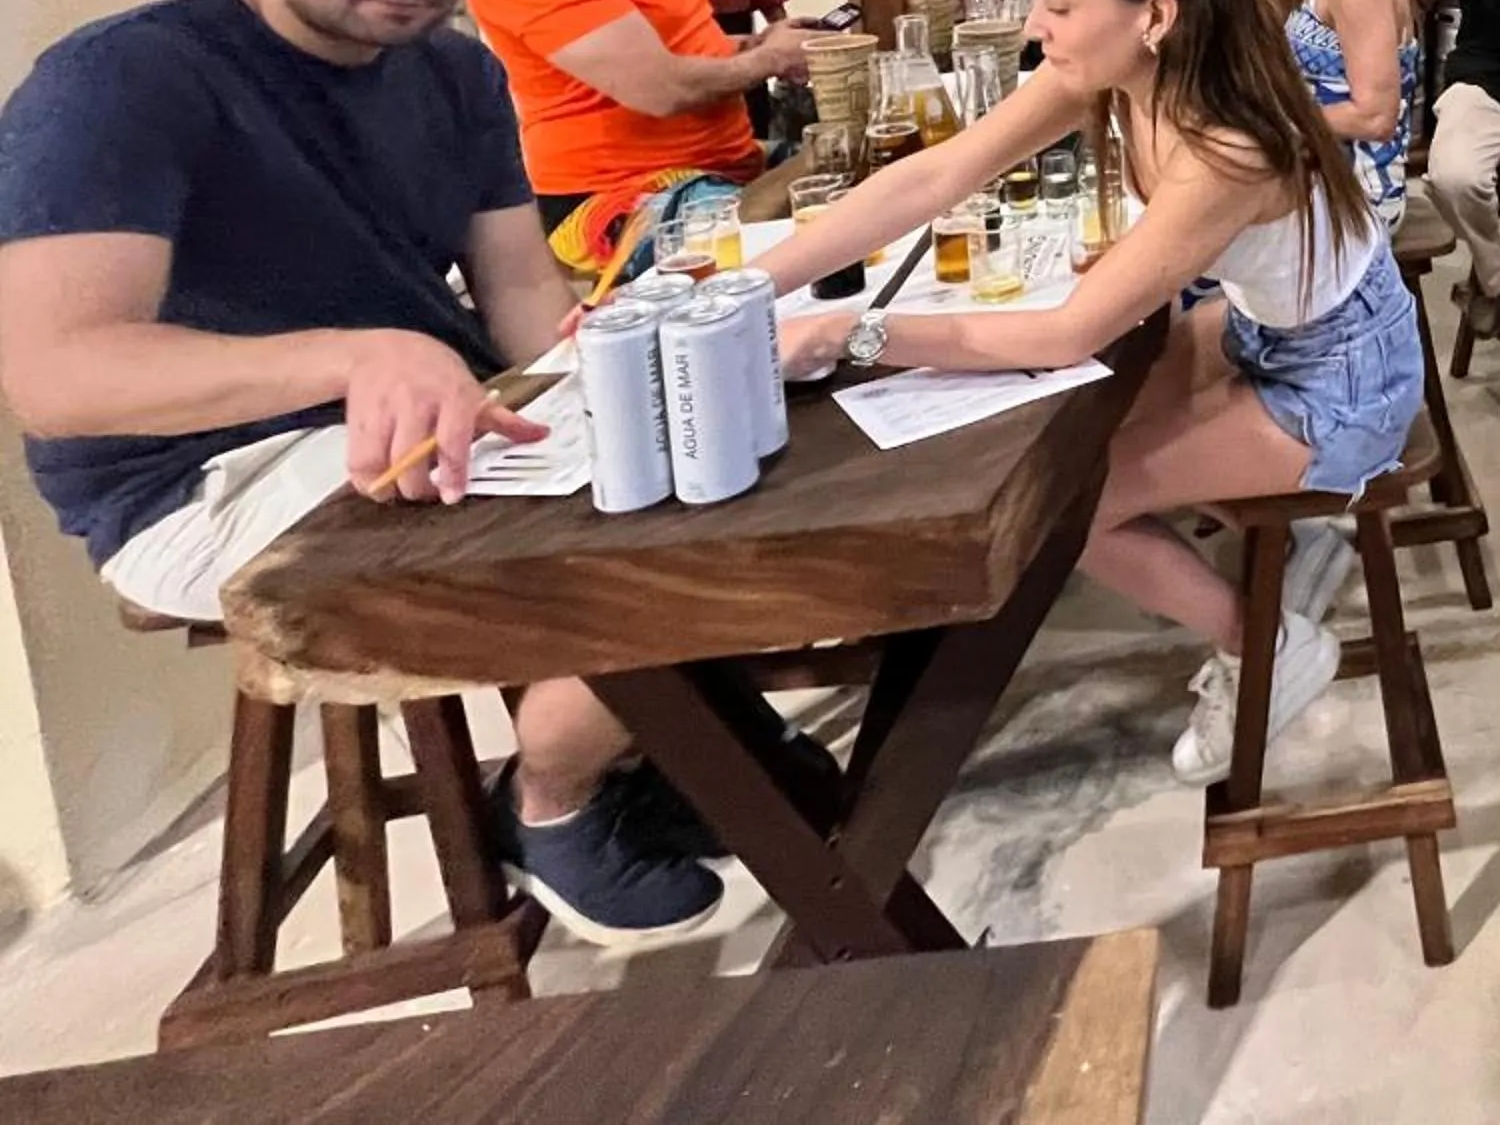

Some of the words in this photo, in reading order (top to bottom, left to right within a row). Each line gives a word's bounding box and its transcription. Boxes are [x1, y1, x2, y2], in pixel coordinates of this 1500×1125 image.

[675, 354, 691, 388] MAR
[680, 393, 693, 414] DE
[682, 417, 698, 460] AGUA
